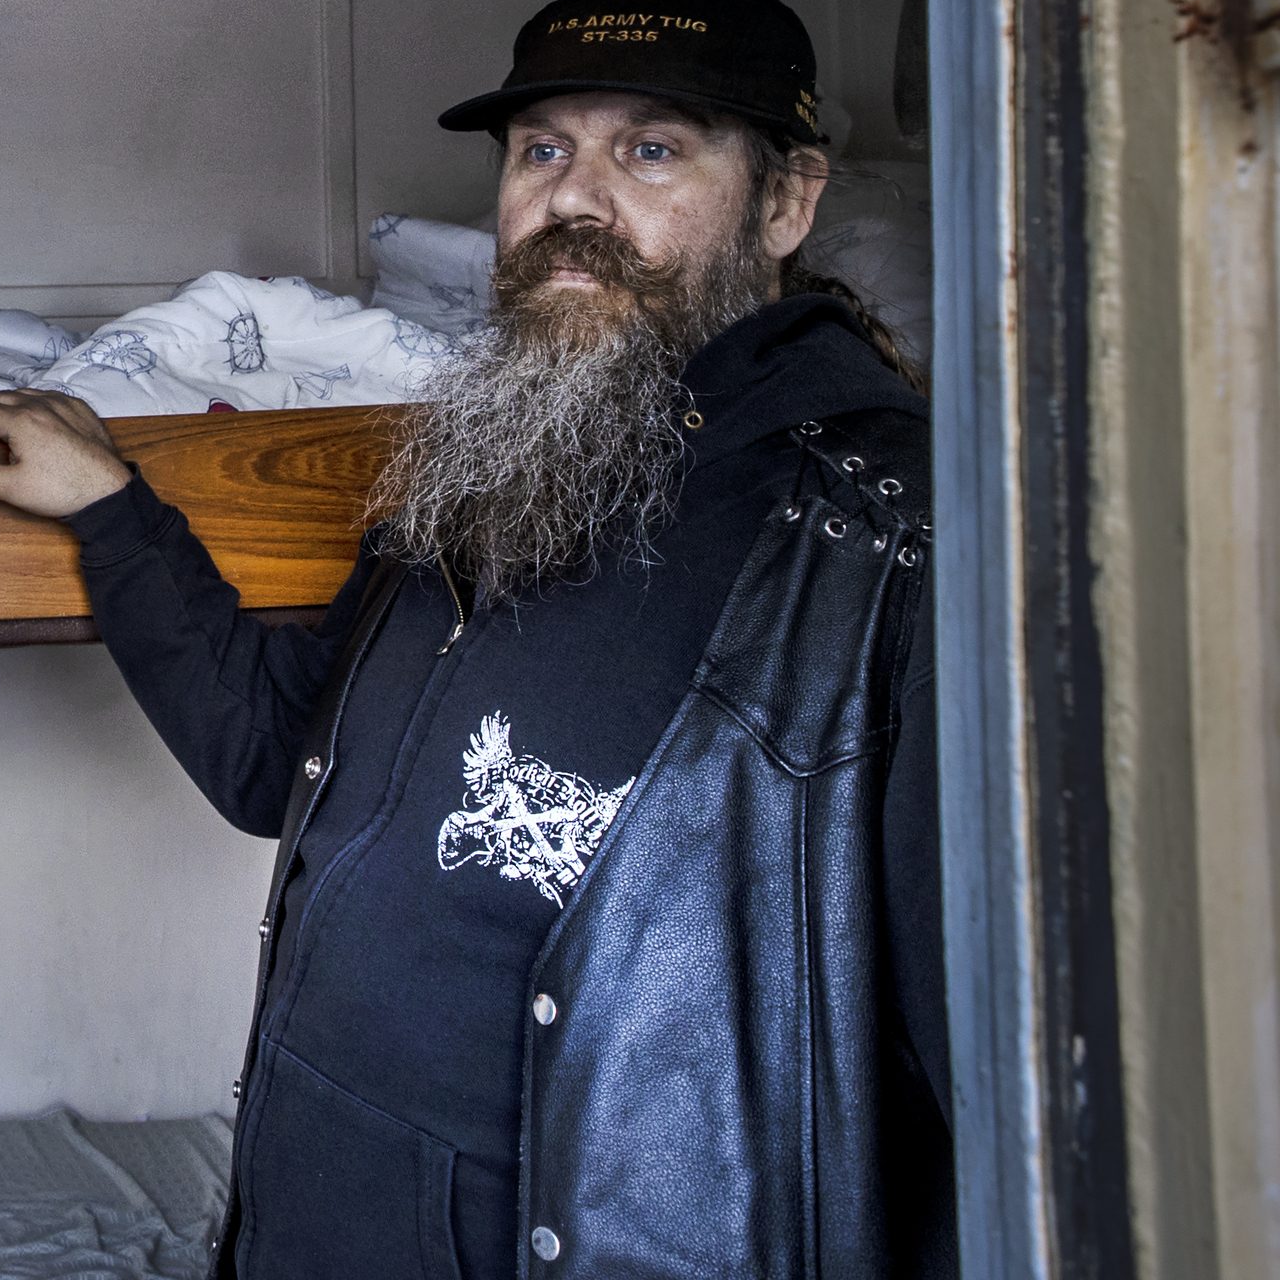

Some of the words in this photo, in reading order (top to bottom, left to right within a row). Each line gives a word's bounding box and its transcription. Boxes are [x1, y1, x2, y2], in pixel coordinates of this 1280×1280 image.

[583, 13, 654, 29] ARMY
[659, 15, 708, 33] TUG
[581, 30, 660, 43] ST-335
